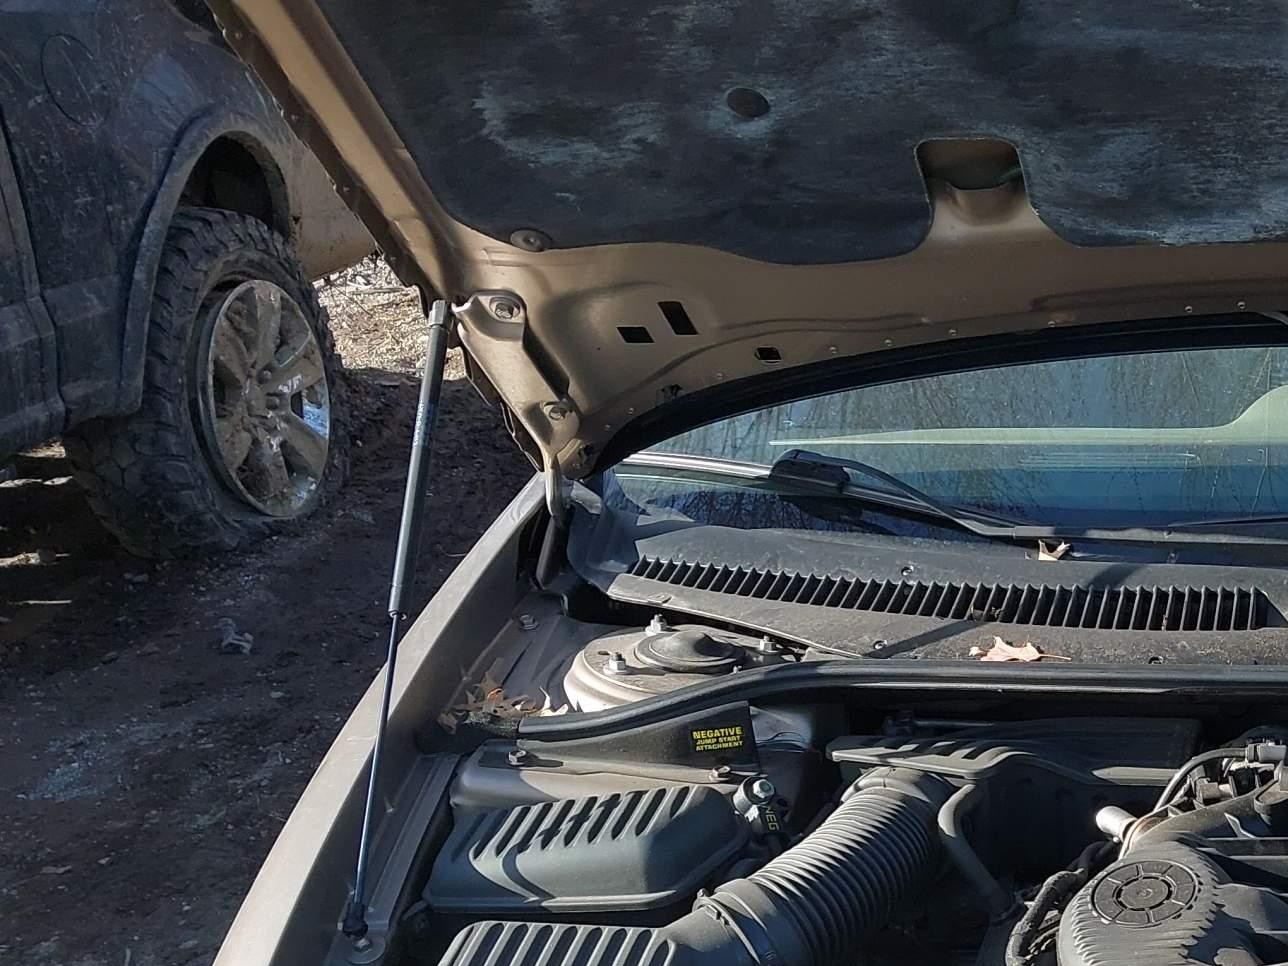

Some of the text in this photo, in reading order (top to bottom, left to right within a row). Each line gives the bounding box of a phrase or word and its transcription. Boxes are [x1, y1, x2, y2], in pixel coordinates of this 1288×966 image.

[692, 727, 742, 739] NEGATIVE
[718, 735, 741, 743] START
[695, 741, 743, 751] ATTACHMENT
[765, 807, 779, 831] NEG
